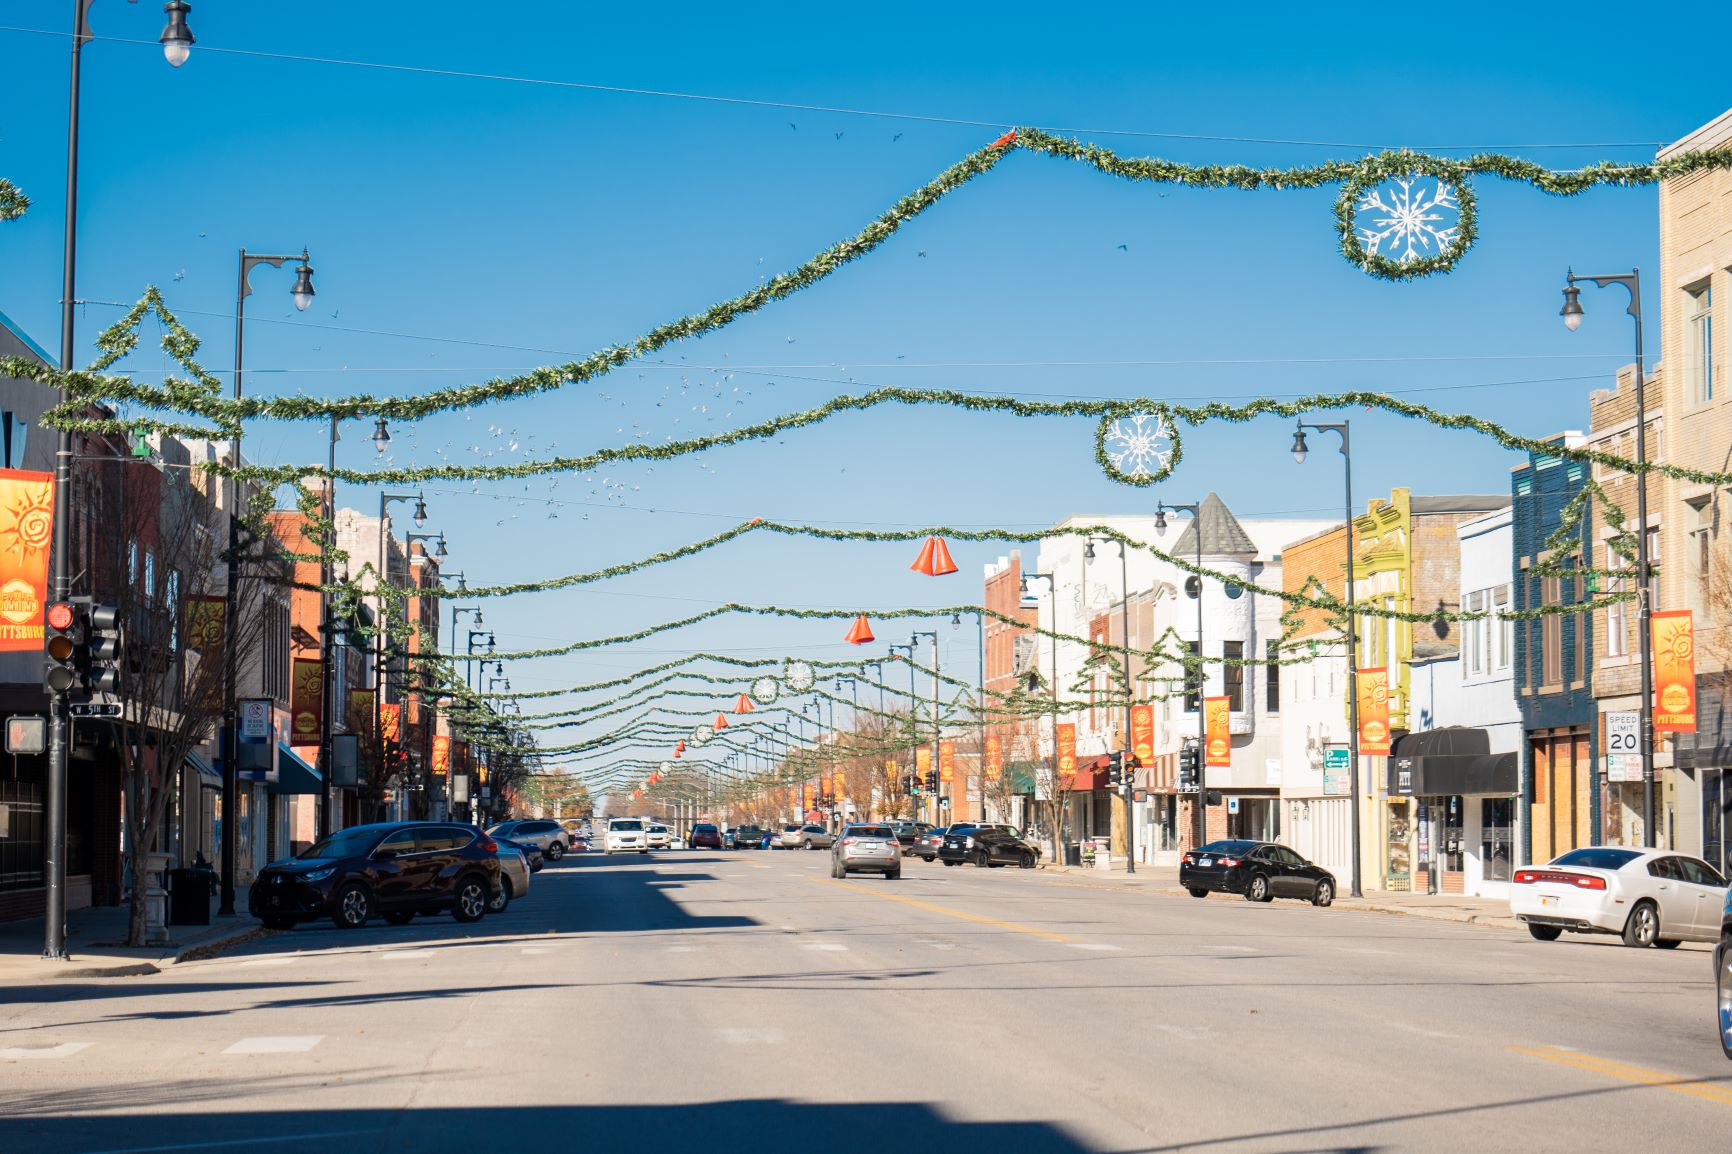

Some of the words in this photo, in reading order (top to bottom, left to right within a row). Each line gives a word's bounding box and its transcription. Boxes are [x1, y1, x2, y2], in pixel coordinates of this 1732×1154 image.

[0, 624, 45, 639] TTSBURG
[76, 706, 81, 714] W
[108, 705, 115, 714] ST
[1609, 716, 1637, 724] SPEED
[1612, 724, 1634, 732] LIMIT
[1610, 733, 1637, 749] 20
